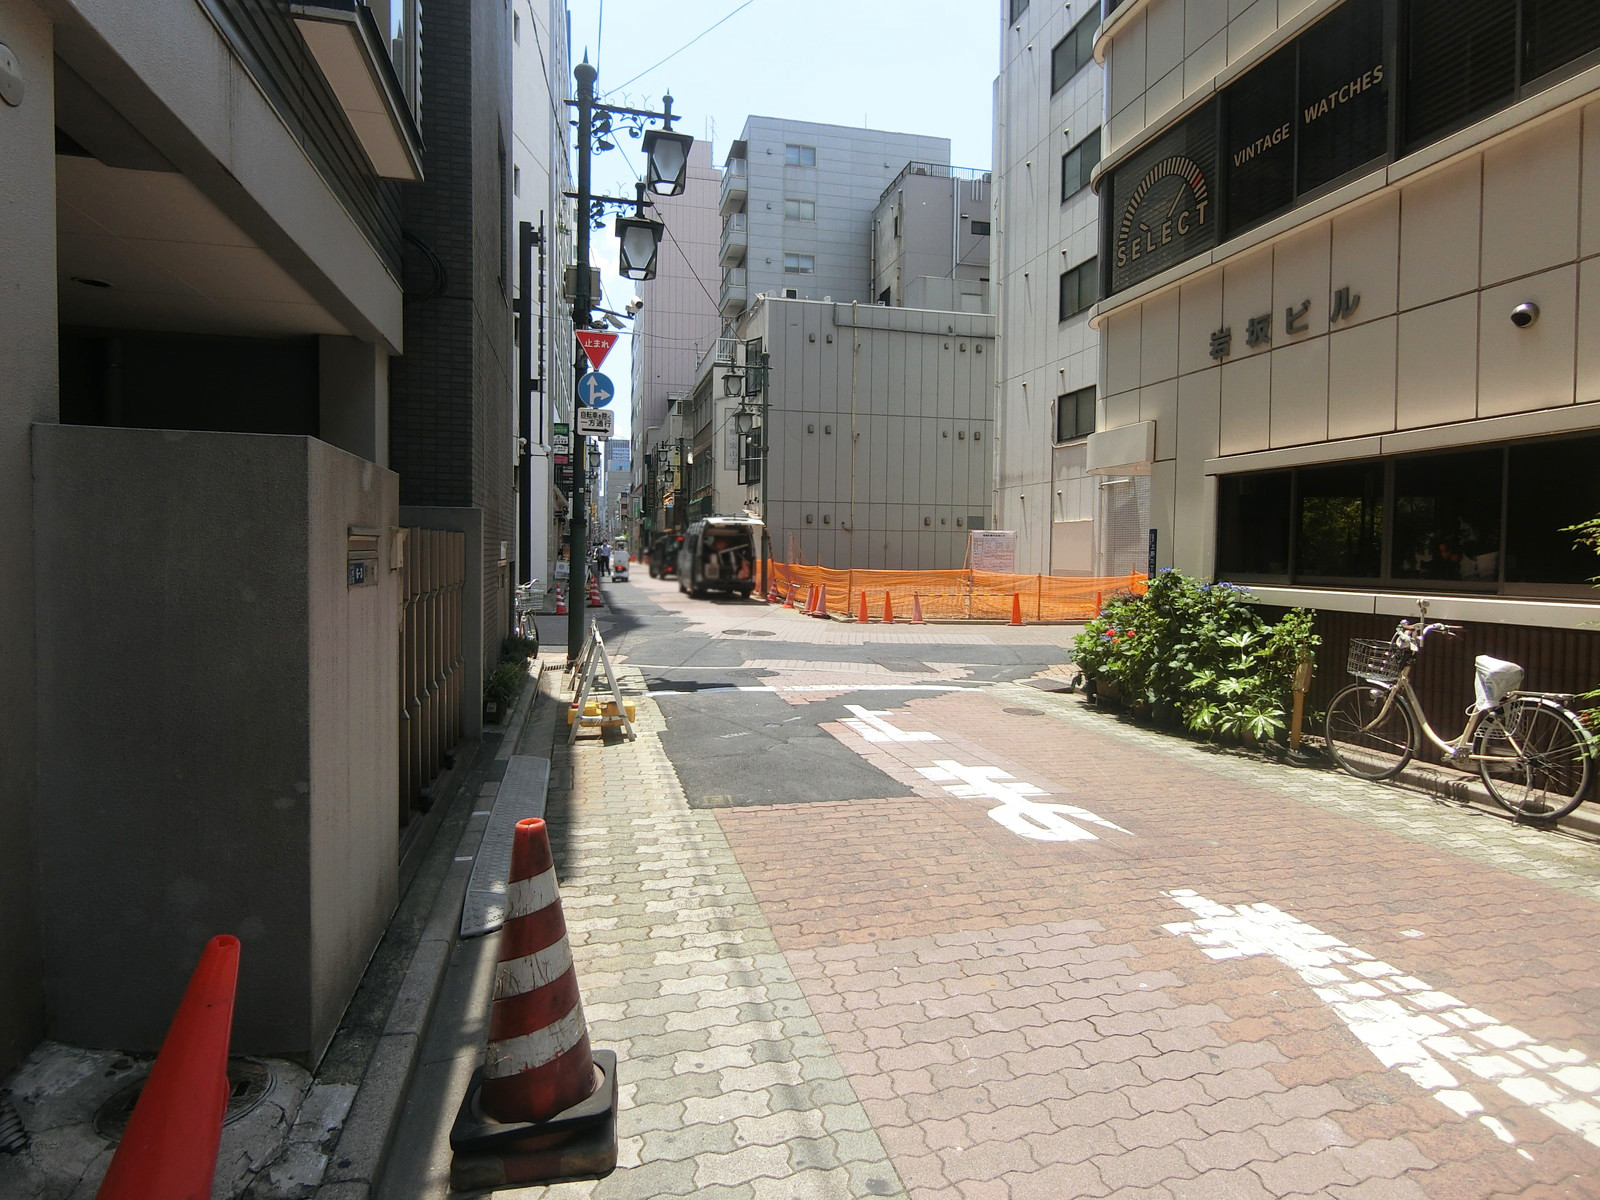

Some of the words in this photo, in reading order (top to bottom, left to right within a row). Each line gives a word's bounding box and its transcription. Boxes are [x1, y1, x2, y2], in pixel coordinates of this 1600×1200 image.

[1233, 122, 1290, 167] VINTAGE
[1304, 64, 1384, 124] WATCHES
[1116, 200, 1208, 268] SELECT
[1209, 287, 1361, 360] 岩坂ビル
[584, 338, 610, 349] 止まれ
[580, 410, 612, 420] 自転車を除く
[580, 419, 612, 428] 一方通行
